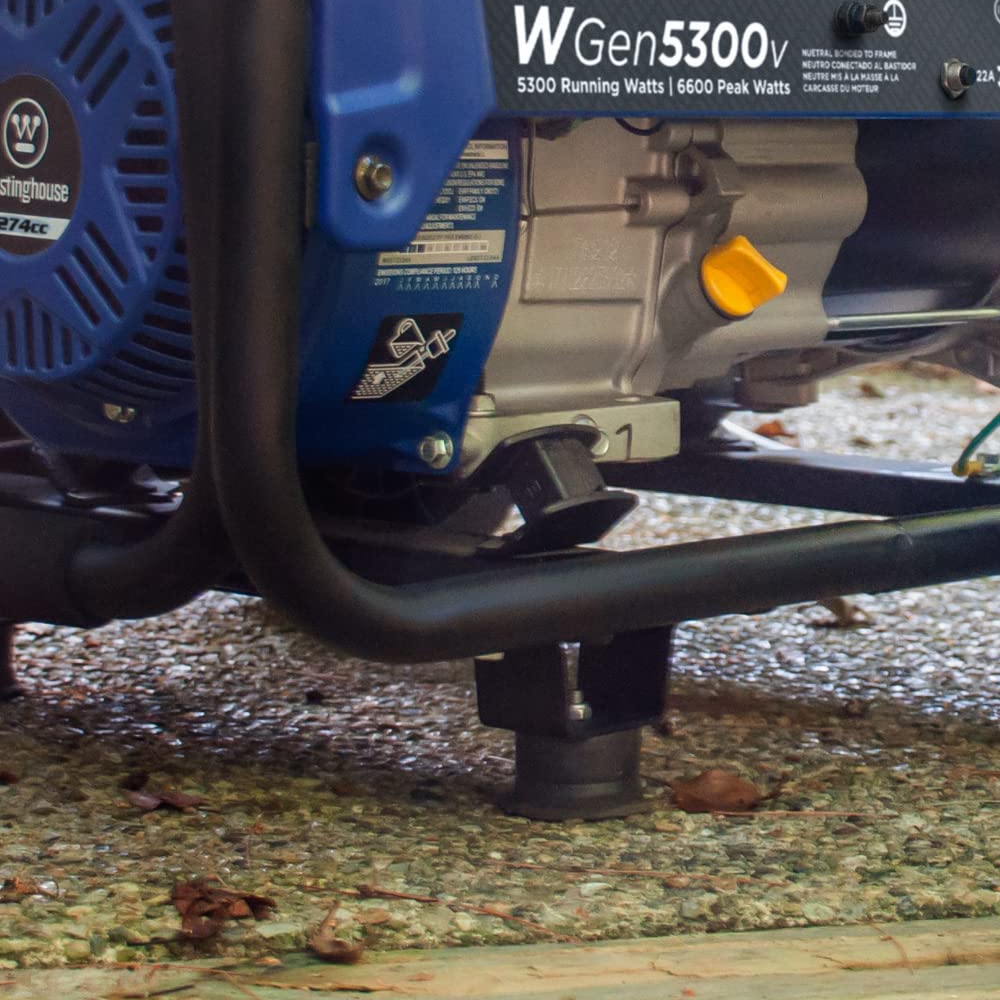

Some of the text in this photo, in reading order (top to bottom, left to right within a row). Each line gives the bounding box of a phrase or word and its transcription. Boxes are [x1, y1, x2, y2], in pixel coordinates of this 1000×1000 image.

[864, 50, 873, 59] TO
[875, 50, 897, 59] FRAME
[802, 61, 830, 70] NEUTRO
[831, 61, 872, 70] CONECTADO
[874, 62, 883, 70] AL
[803, 72, 829, 81] NEUTRE
[850, 73, 860, 81] LA
[861, 73, 883, 82] MASSE
[891, 73, 900, 82] LA
[517, 76, 791, 97] 5300 Running Watts 6600 Peak Watts
[803, 83, 879, 94] CARCASSE DU MOTEUR
[0, 216, 48, 234] 274cc
